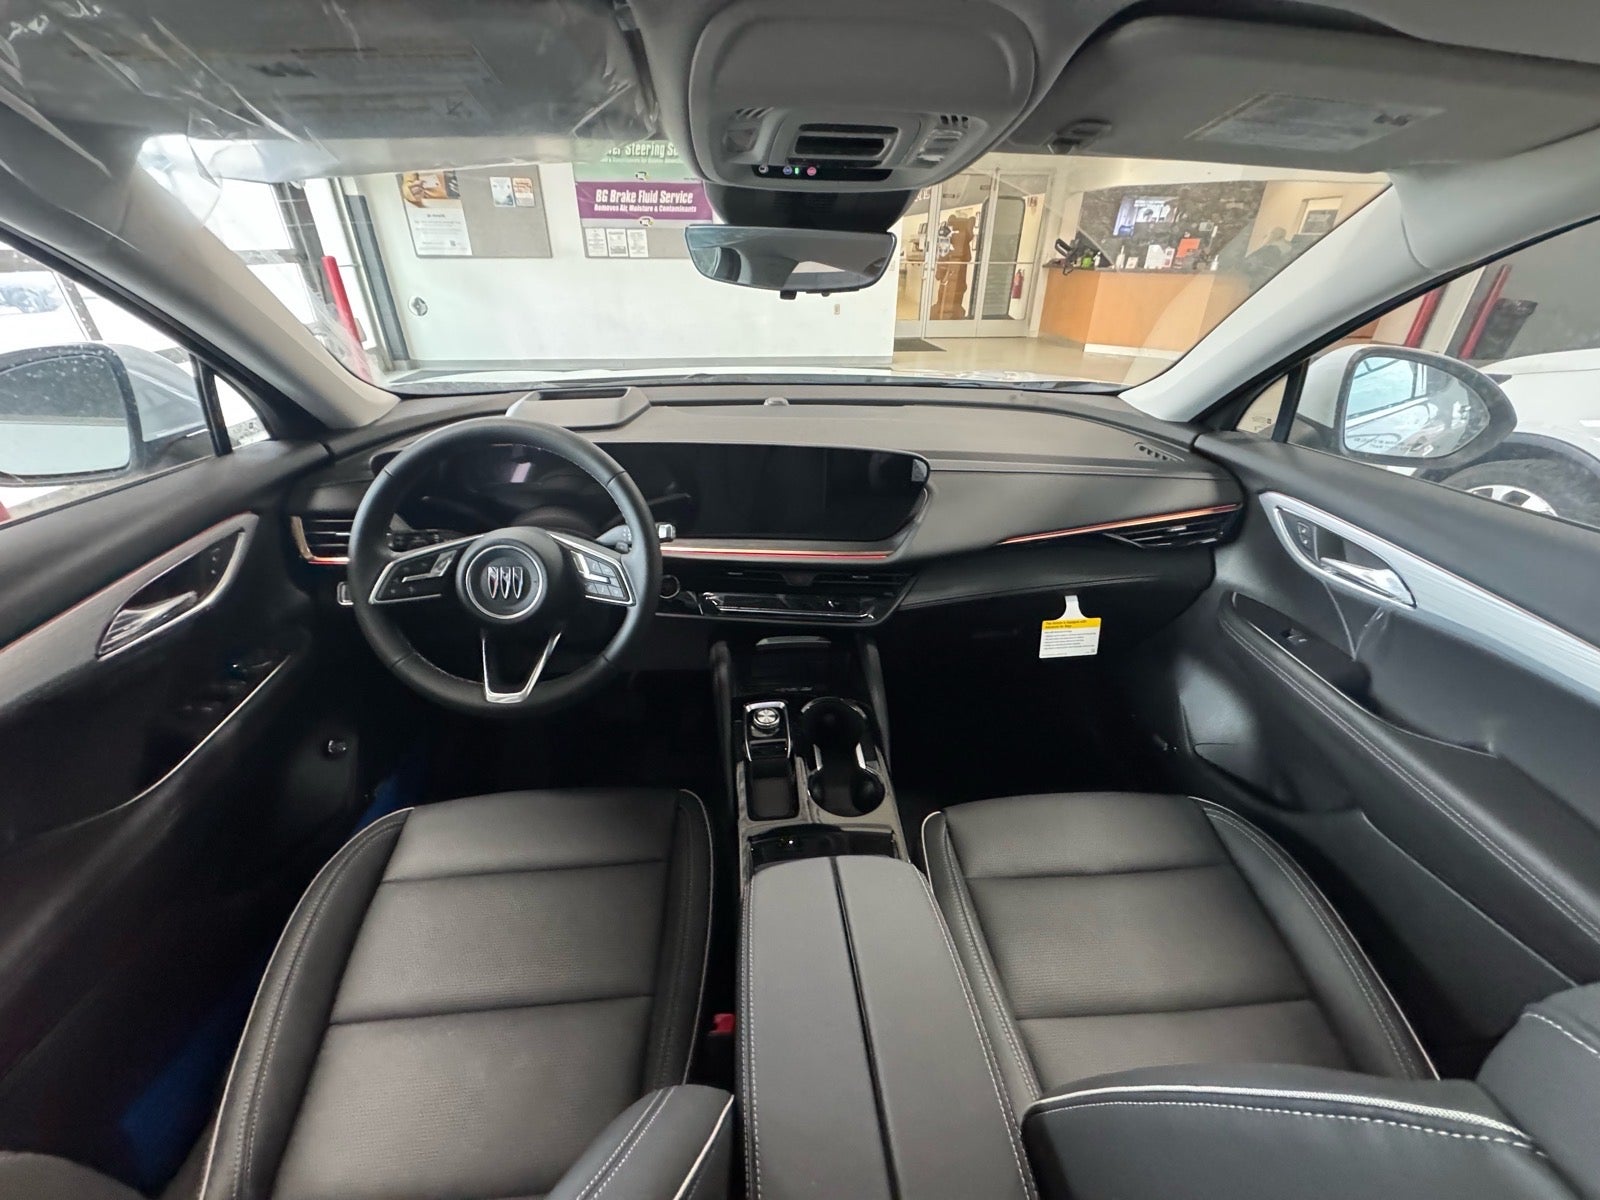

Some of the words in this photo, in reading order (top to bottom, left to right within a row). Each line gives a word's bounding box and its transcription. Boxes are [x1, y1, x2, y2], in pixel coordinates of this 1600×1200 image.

[625, 142, 665, 158] Steering
[595, 189, 608, 203] BG
[609, 189, 636, 204] Brake
[638, 189, 658, 204] Fluid
[660, 190, 693, 204] Service
[594, 203, 619, 212] Removes
[629, 204, 653, 212] Moisture
[654, 205, 659, 213] &
[659, 205, 697, 213] Contaminants
